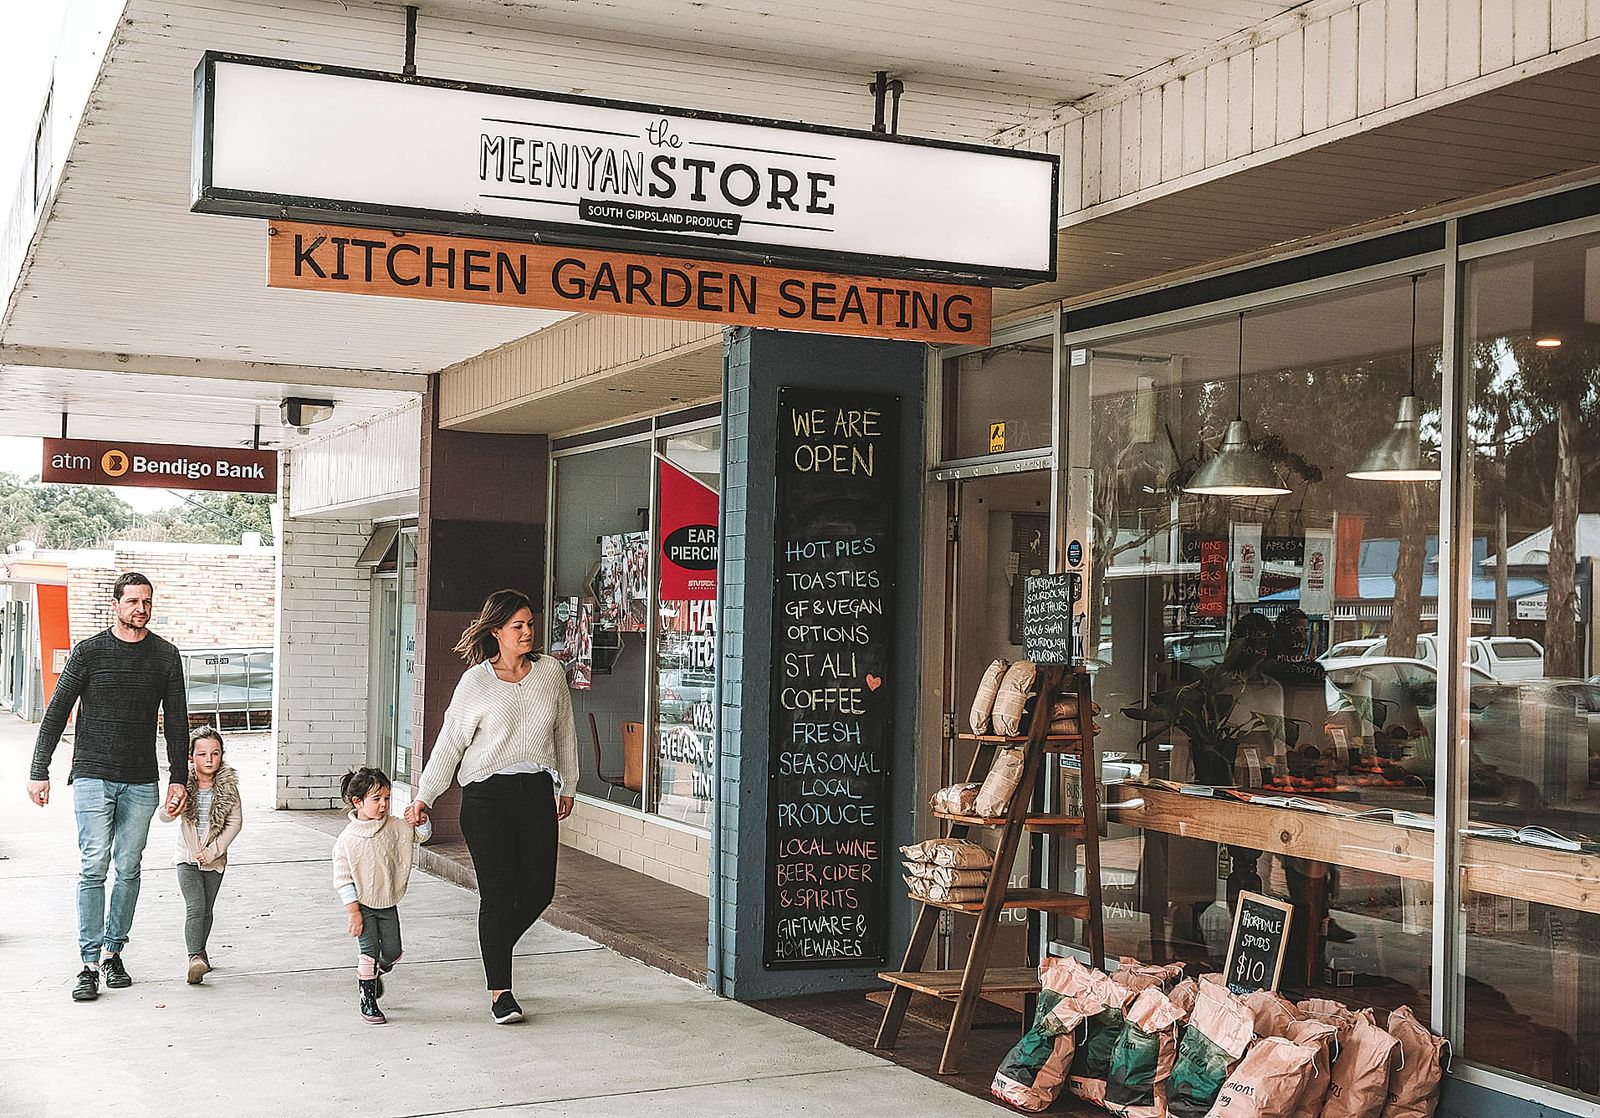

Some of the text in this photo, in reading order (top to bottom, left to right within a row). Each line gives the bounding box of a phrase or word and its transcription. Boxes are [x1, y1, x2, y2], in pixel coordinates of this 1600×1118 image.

[645, 119, 683, 149] the
[479, 134, 836, 215] MEENIYAN STORE
[588, 205, 734, 229] SOUTH GIPPSLAND PRODUCE
[295, 234, 973, 333] KITCHEN GARDEN SEATING
[792, 408, 882, 438] WE ARE
[51, 453, 264, 479] atm Bendigo Bank
[795, 443, 873, 477] OPEN
[688, 529, 715, 543] EAR
[1187, 541, 1221, 551] ONIONS
[671, 546, 718, 560] PIERCIN
[785, 537, 876, 562] HOT PIES
[786, 570, 880, 591] TOASTIES
[785, 599, 809, 619] GF
[826, 598, 883, 617] VEGAN
[1185, 602, 1222, 611] CARROTS
[787, 625, 870, 645] OPTIONS
[785, 652, 857, 679] ST ALI
[781, 687, 866, 714] COFFEE
[792, 721, 861, 744] FRESH
[779, 751, 882, 775] SEASONAL
[802, 779, 863, 799] LOCAL
[778, 802, 875, 827] PRODUCE
[779, 837, 879, 860] LOCAL WINE
[823, 863, 873, 883] CIDER
[780, 888, 859, 910] & SPIRITS
[777, 915, 853, 941] GIFTWARE
[776, 937, 863, 959] HOMEWARES
[1241, 934, 1270, 952] SPUDS
[1236, 951, 1265, 982] $10
